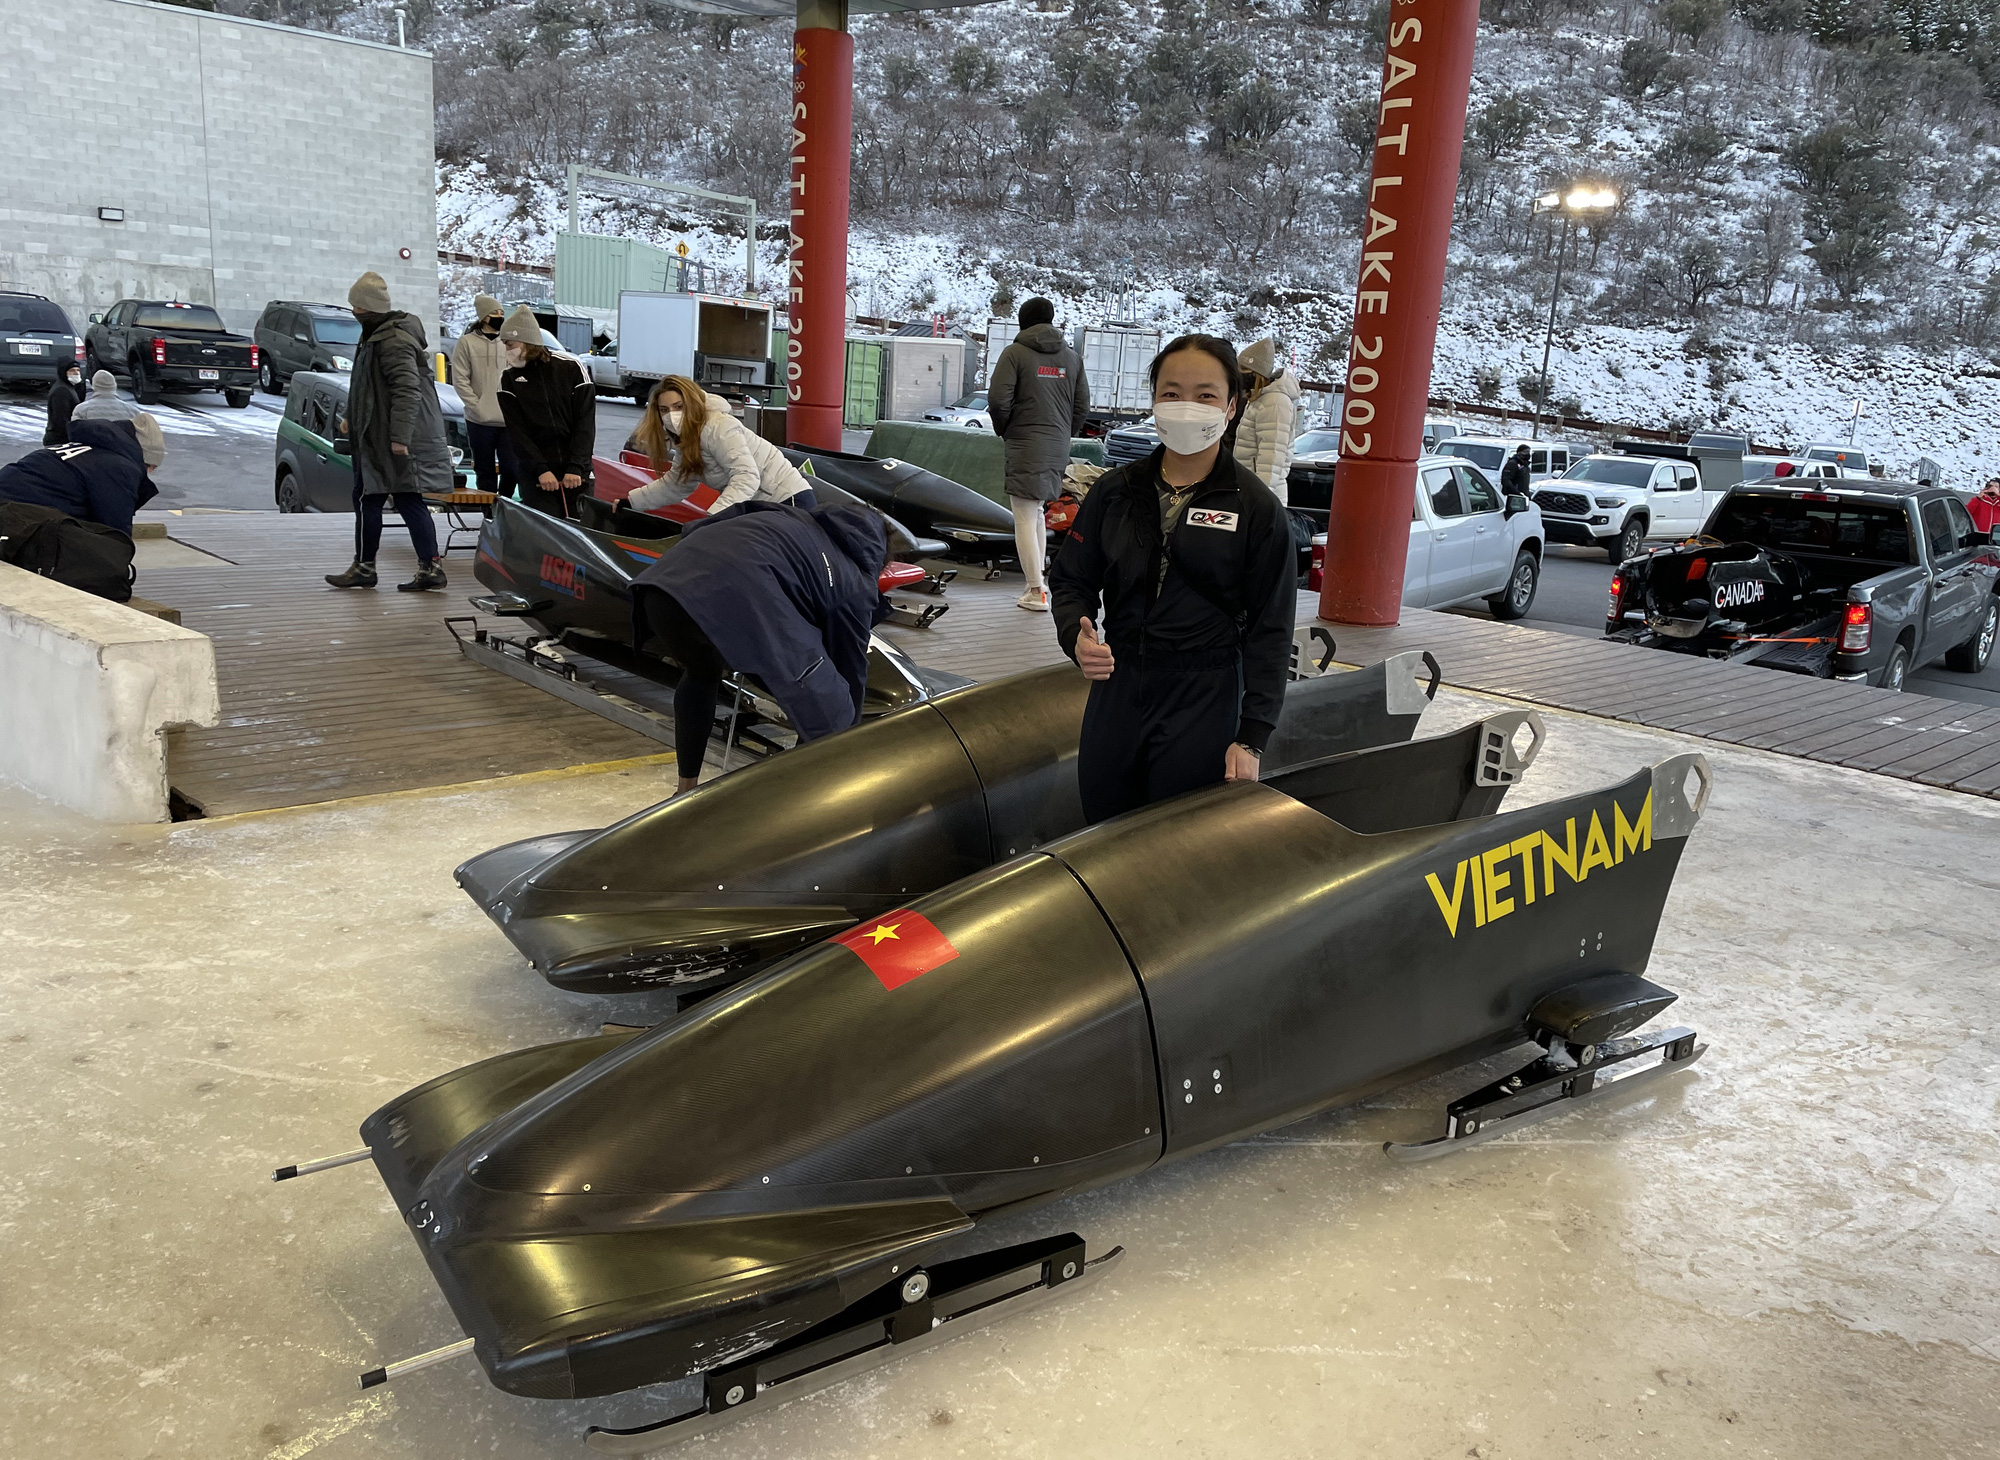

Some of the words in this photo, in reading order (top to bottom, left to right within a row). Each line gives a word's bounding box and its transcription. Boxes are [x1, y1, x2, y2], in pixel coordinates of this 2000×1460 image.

[1378, 18, 1422, 156] SALT
[790, 102, 807, 196] SALT
[788, 209, 805, 304] LAKE
[1358, 176, 1403, 315] LAKE
[787, 318, 803, 402] 2002
[1341, 335, 1383, 456] 2002
[1191, 512, 1233, 525] QXZ
[540, 554, 575, 588] USA
[1715, 580, 1760, 608] CANADA
[1425, 786, 1652, 938] VIETNAM
